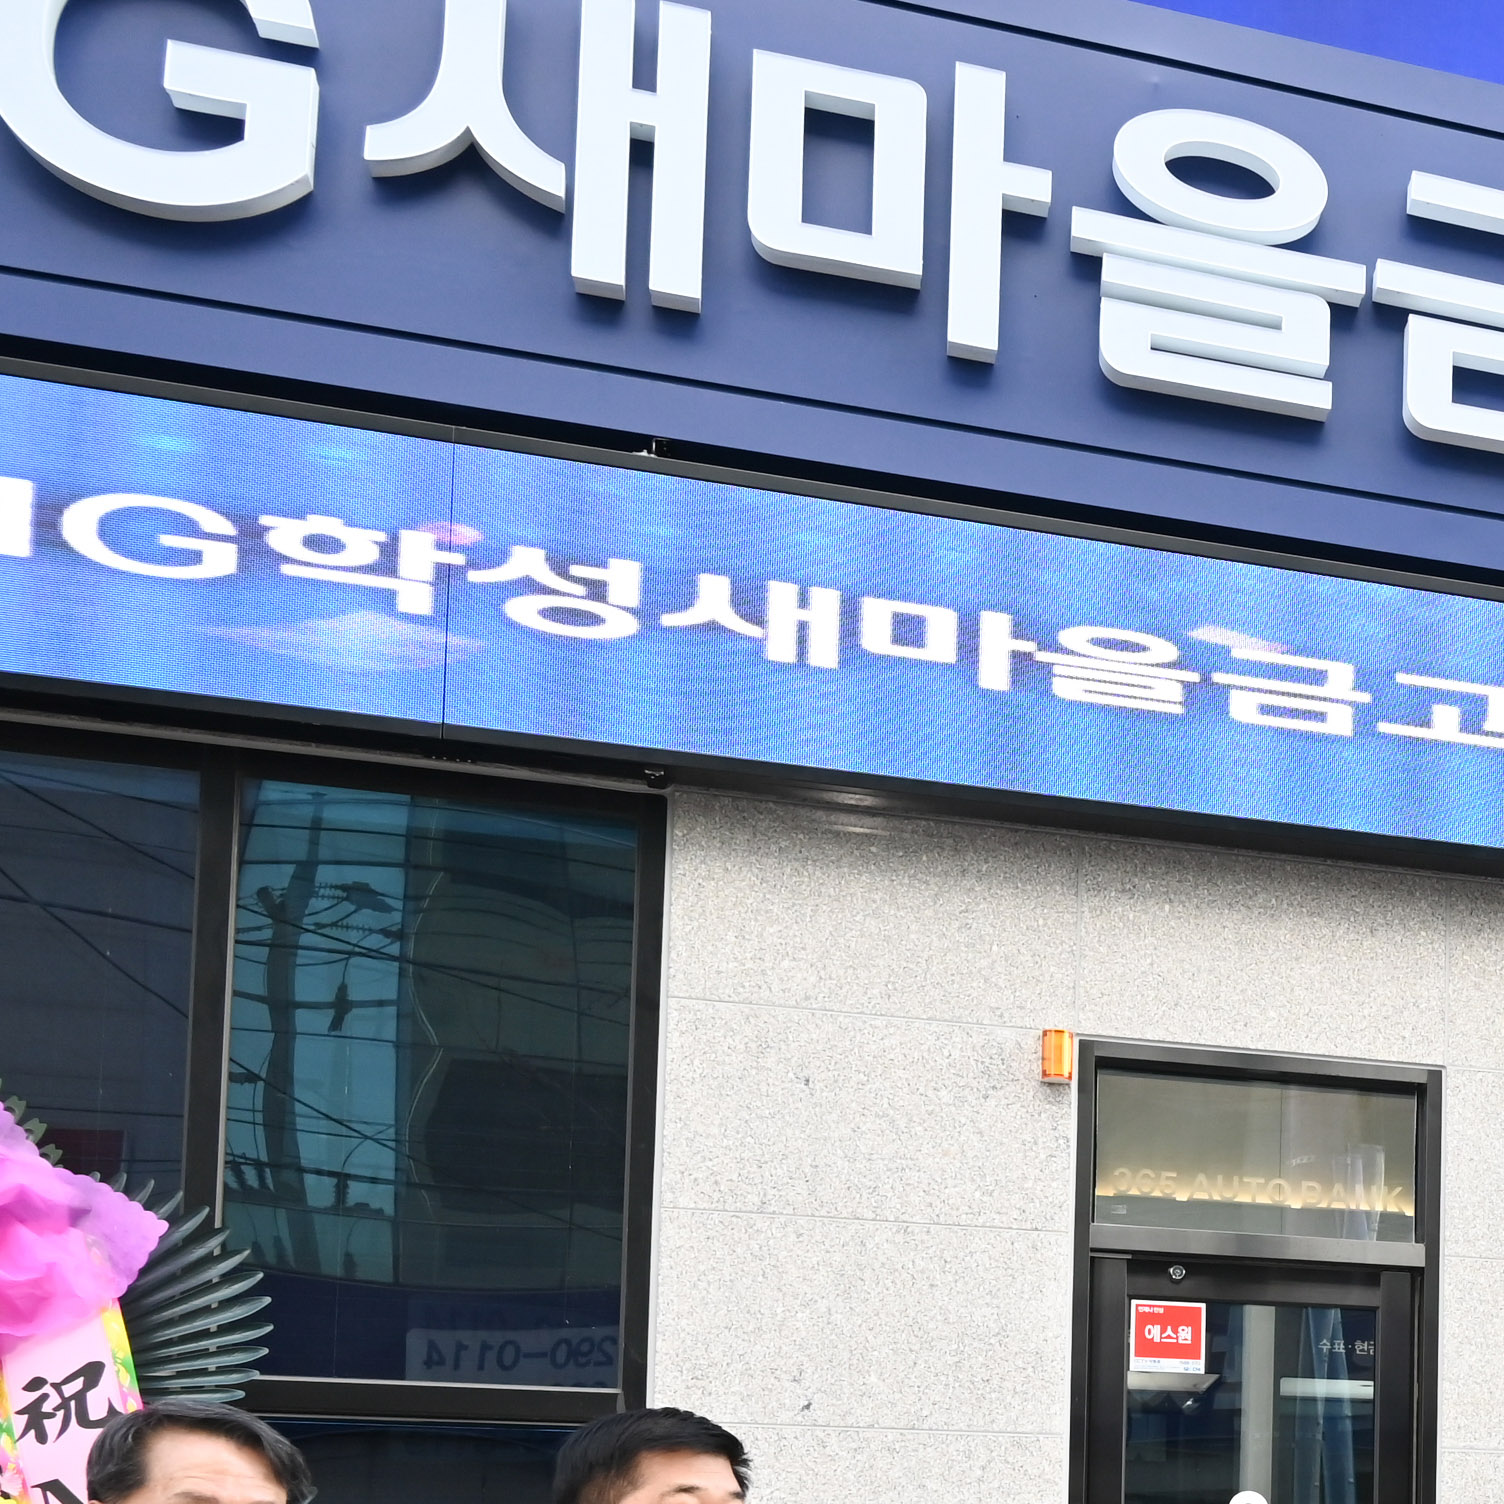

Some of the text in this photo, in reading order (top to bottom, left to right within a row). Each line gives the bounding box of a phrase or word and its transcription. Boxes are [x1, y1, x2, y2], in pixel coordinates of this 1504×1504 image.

[1113, 1167, 1406, 1212] 365 AUTO BANK
[1144, 1324, 1192, 1344] 에스원
[14, 1360, 126, 1445] 祝
